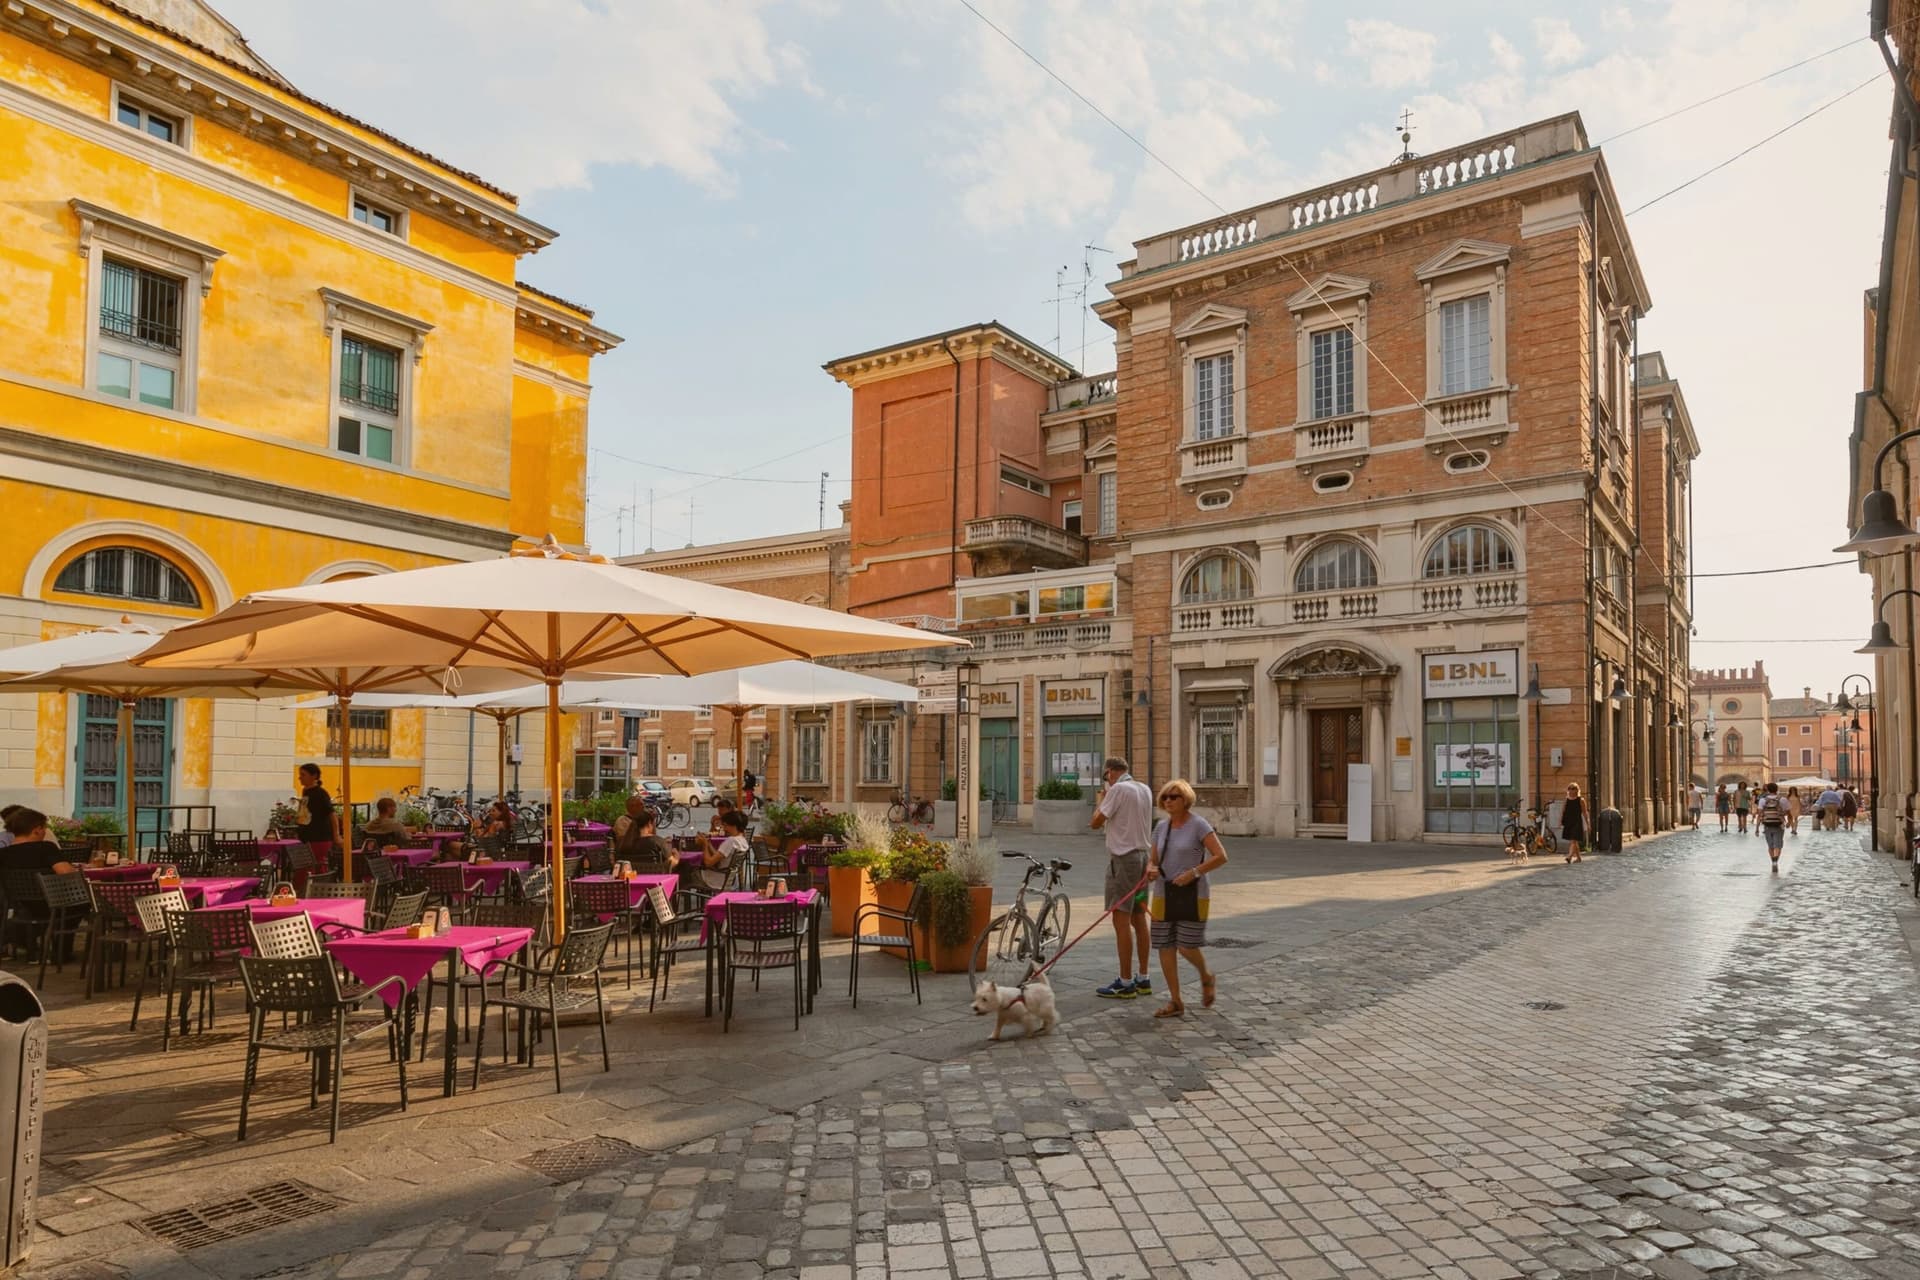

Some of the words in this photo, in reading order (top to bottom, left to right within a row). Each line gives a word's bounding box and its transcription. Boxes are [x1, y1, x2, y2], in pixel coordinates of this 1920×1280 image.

[1449, 661, 1506, 680] BNL
[980, 692, 1012, 705] BNL
[1059, 688, 1096, 702] BNL
